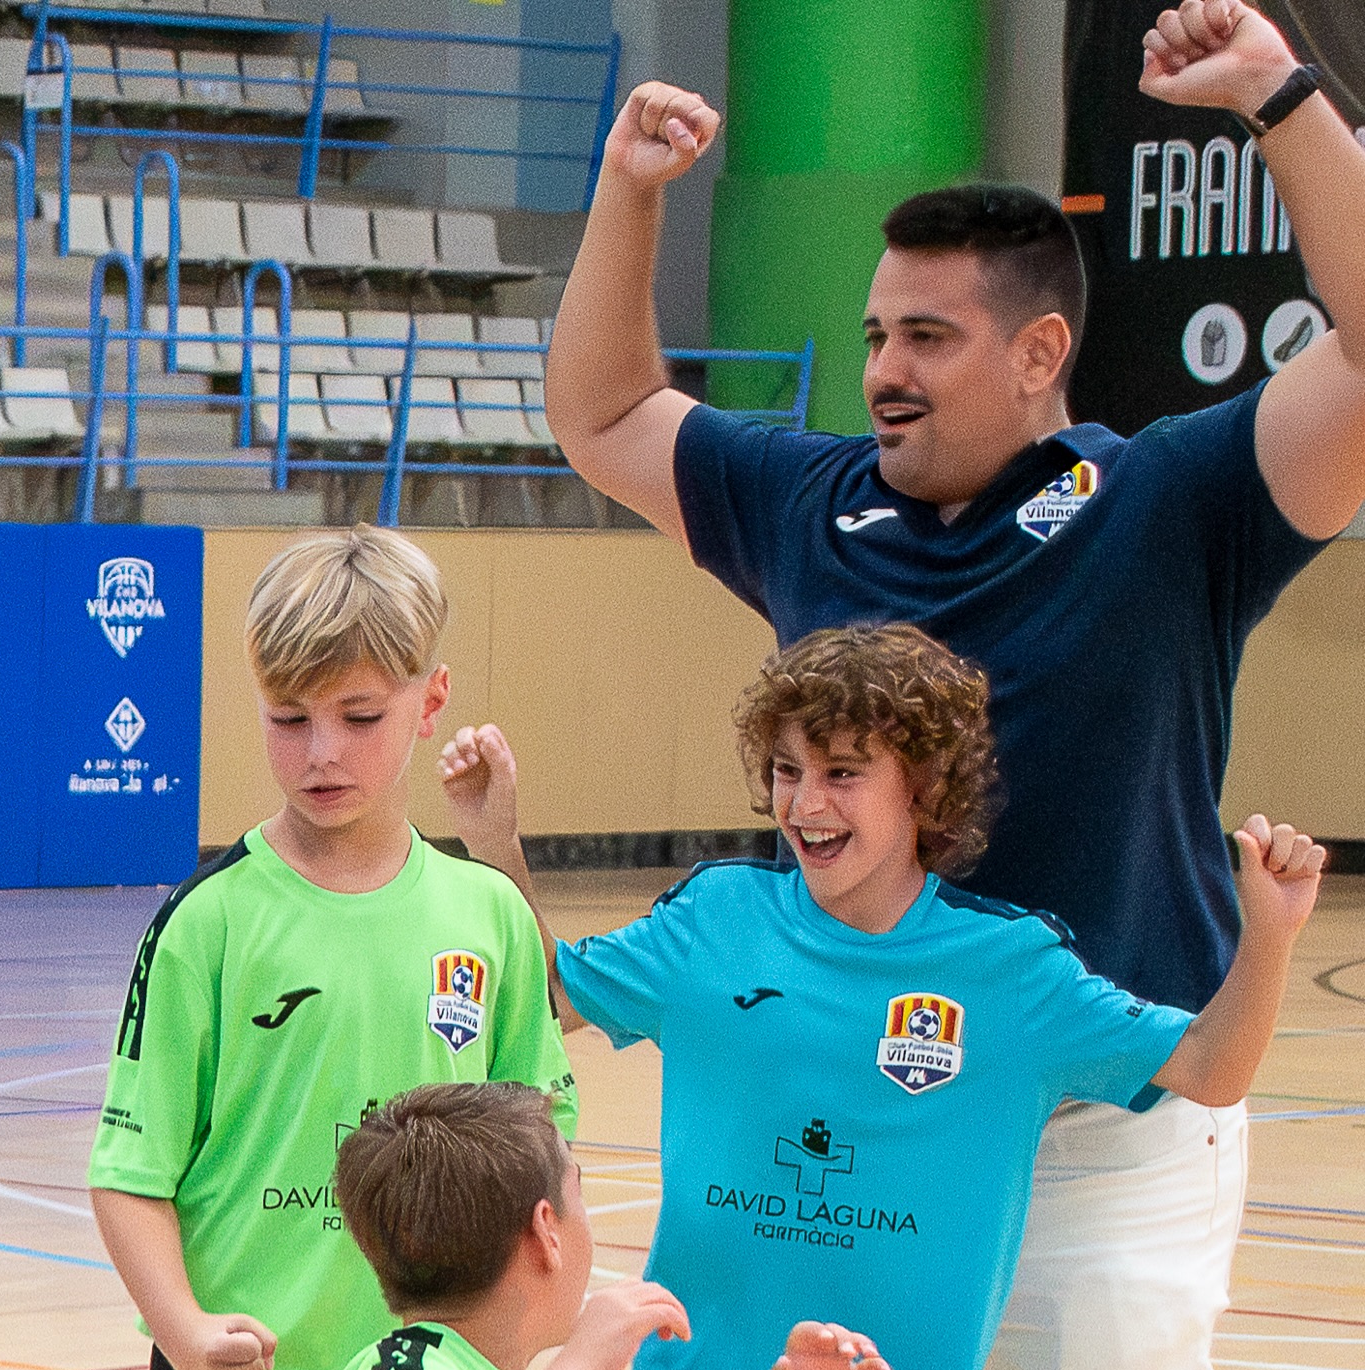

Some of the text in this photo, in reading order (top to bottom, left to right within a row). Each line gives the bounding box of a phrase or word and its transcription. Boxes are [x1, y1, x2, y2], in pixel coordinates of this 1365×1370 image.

[1129, 136, 1291, 259] FRAN
[1026, 505, 1076, 519] Vilano
[436, 1006, 478, 1029] Vilanova
[886, 1049, 953, 1069] Vilanova
[706, 1184, 919, 1235] DAVID LAGUNA
